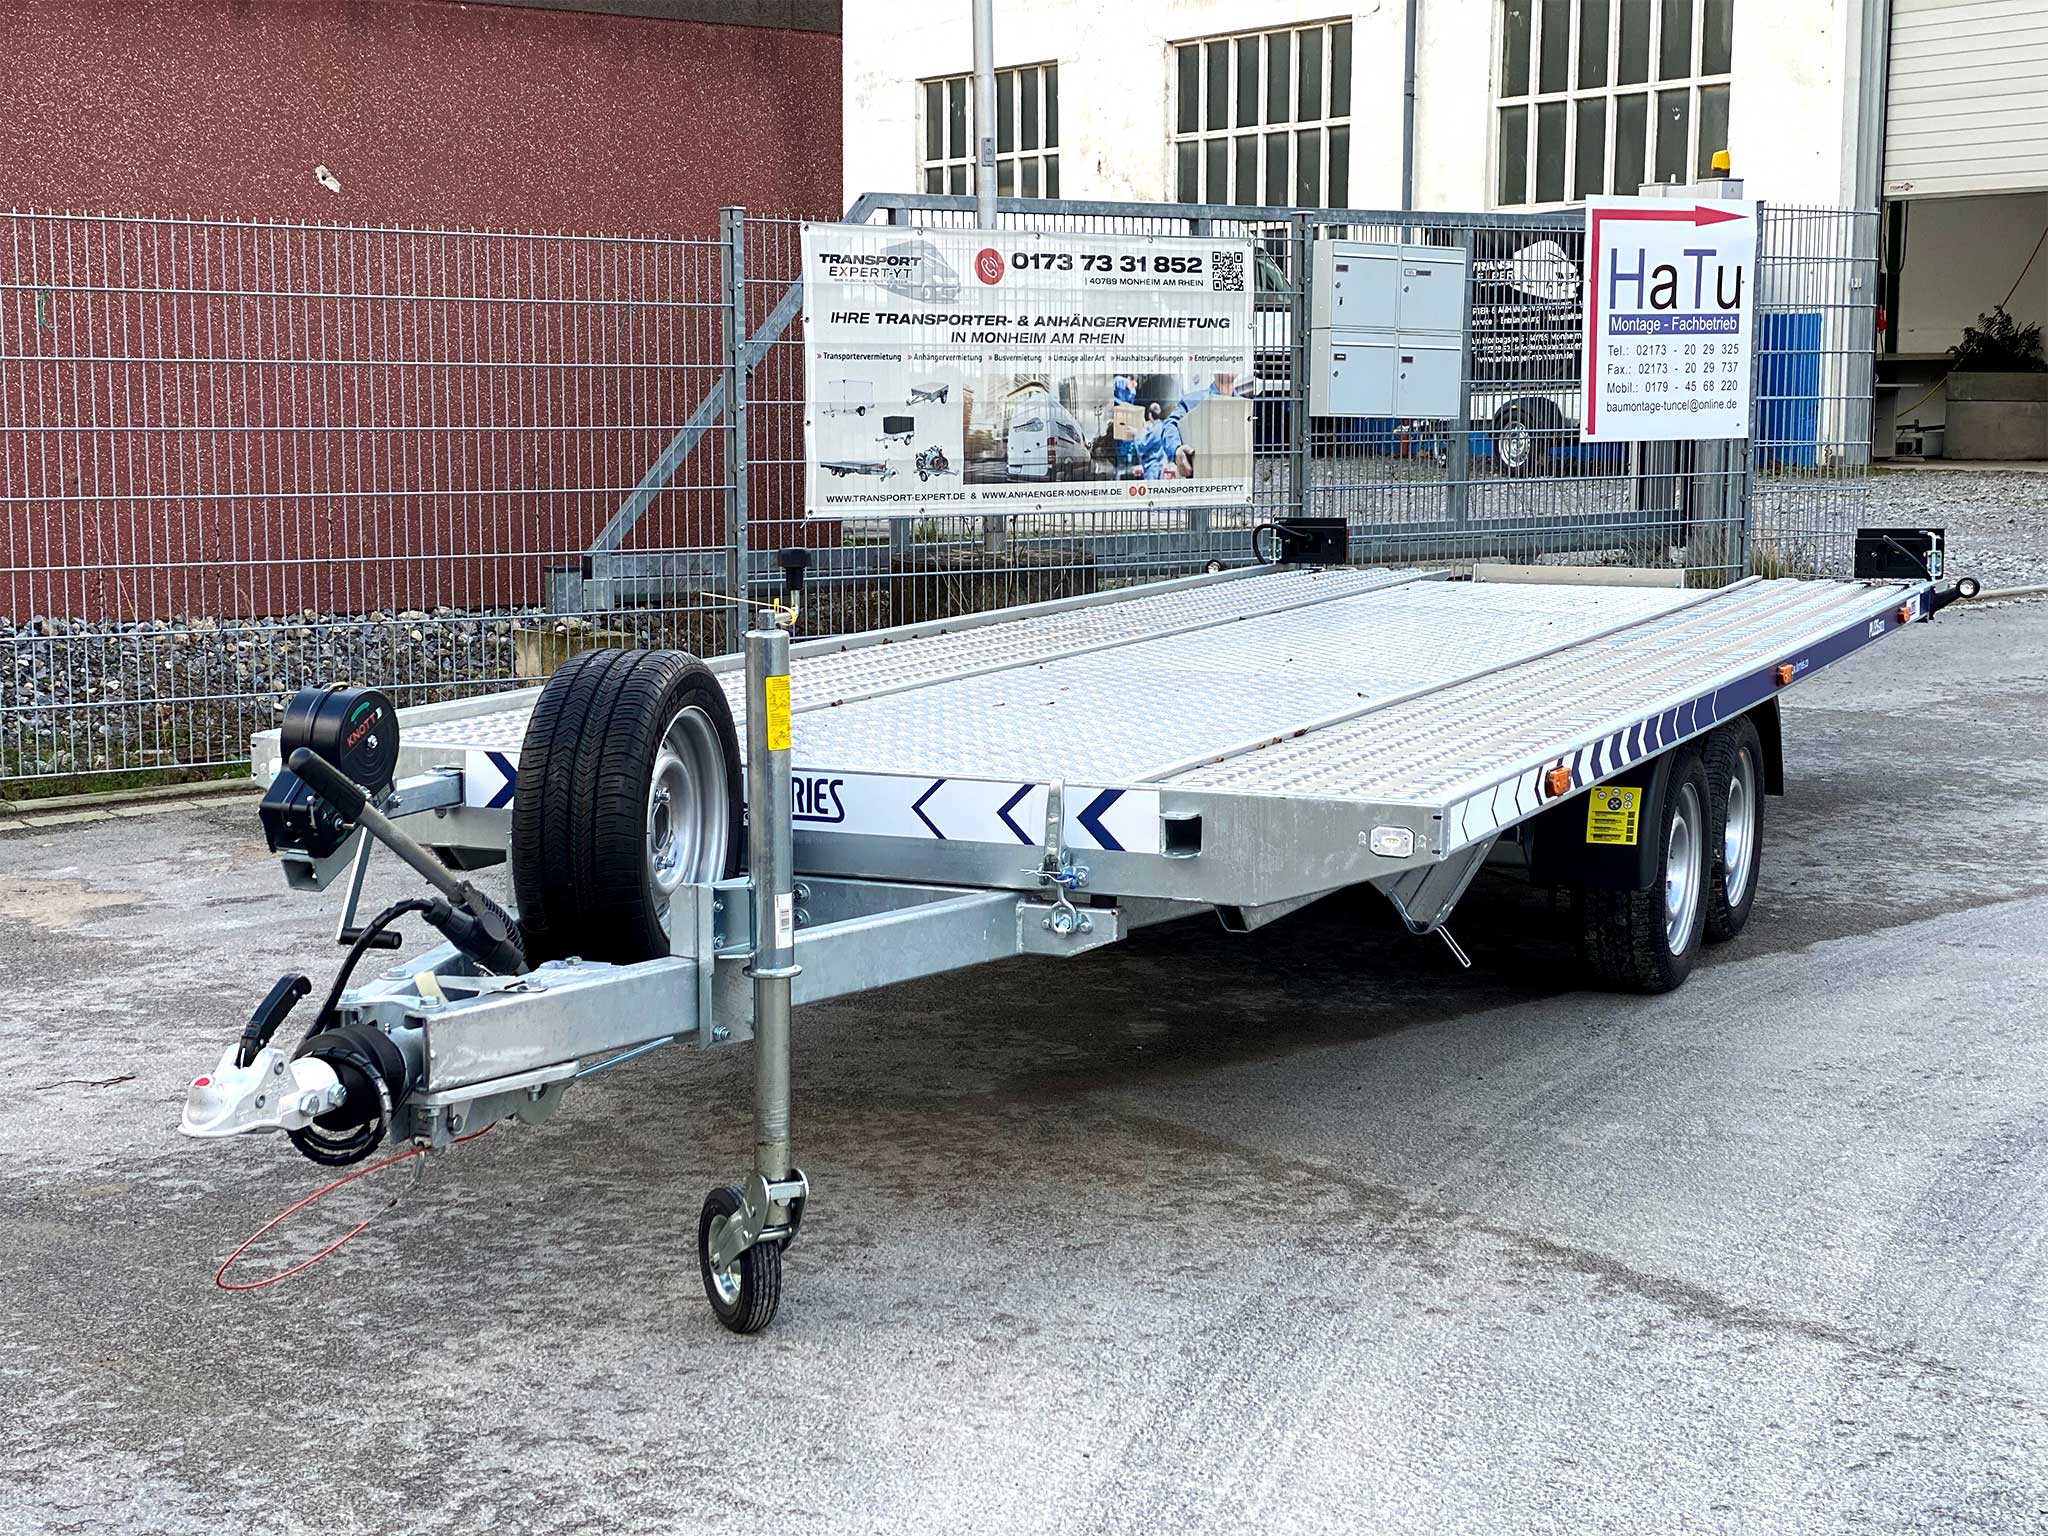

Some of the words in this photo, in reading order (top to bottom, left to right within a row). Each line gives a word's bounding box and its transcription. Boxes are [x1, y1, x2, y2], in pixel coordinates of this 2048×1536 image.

[818, 253, 922, 267] TRANSPORT
[1011, 252, 1073, 271] 0173
[1079, 254, 1113, 272] 73
[1119, 255, 1147, 273] 31
[1153, 256, 1203, 274] 852
[828, 266, 913, 279] EXPERT-YT
[1609, 248, 1742, 310] HaTu
[1089, 277, 1118, 286] 40789
[1119, 278, 1161, 287] MONHEIM
[1163, 278, 1176, 287] AM
[1178, 279, 1204, 287] RHEIN
[830, 311, 870, 324] IHRE
[875, 313, 1013, 326] TRANSPORTER-
[1017, 315, 1030, 327] &
[1034, 313, 1231, 329] ANHÄNGERVERMIETUNG
[1611, 316, 1661, 335] Montage
[1671, 316, 1737, 331] Fachbetrieb
[951, 332, 967, 343] IN
[970, 332, 1046, 344] MONHEIM
[1050, 333, 1075, 344] AM
[1079, 333, 1125, 344] RHEIN
[1608, 344, 1630, 356] Tel.:
[1636, 344, 1667, 356] 02173
[1684, 344, 1697, 355] 20
[1703, 344, 1715, 355] 29
[1721, 343, 1740, 355] 325
[823, 352, 902, 362] Transportervermietung
[913, 353, 983, 363] Anhängervermietung
[994, 353, 1042, 363] Busvermietung
[1053, 354, 1079, 363] Umzüge
[1080, 354, 1094, 362] aller
[1115, 354, 1184, 363] Haushaltsauflösungen
[1194, 354, 1244, 363] Entrümpelungen
[1607, 363, 1632, 375] Fax.:
[1638, 363, 1668, 375] 02173
[1685, 362, 1697, 374] 20
[1703, 362, 1715, 373] 29
[1721, 361, 1739, 373] 737
[1606, 382, 1639, 394] Mobil.:
[1645, 381, 1669, 393] 0179
[1684, 380, 1697, 392] 45
[1703, 380, 1715, 392] 68
[1720, 379, 1738, 391] 220
[1606, 398, 1737, 414] baumontage-tuncel@online.de
[826, 492, 966, 503] WWW.TRANSPORT-EXPERT.DE
[970, 492, 977, 500] &
[982, 488, 1122, 500] WWW.ANHAENGER-MONHEIM.DE
[1147, 484, 1244, 494] TRANSPORTEXPERTYT
[345, 711, 377, 747] KNOTT
